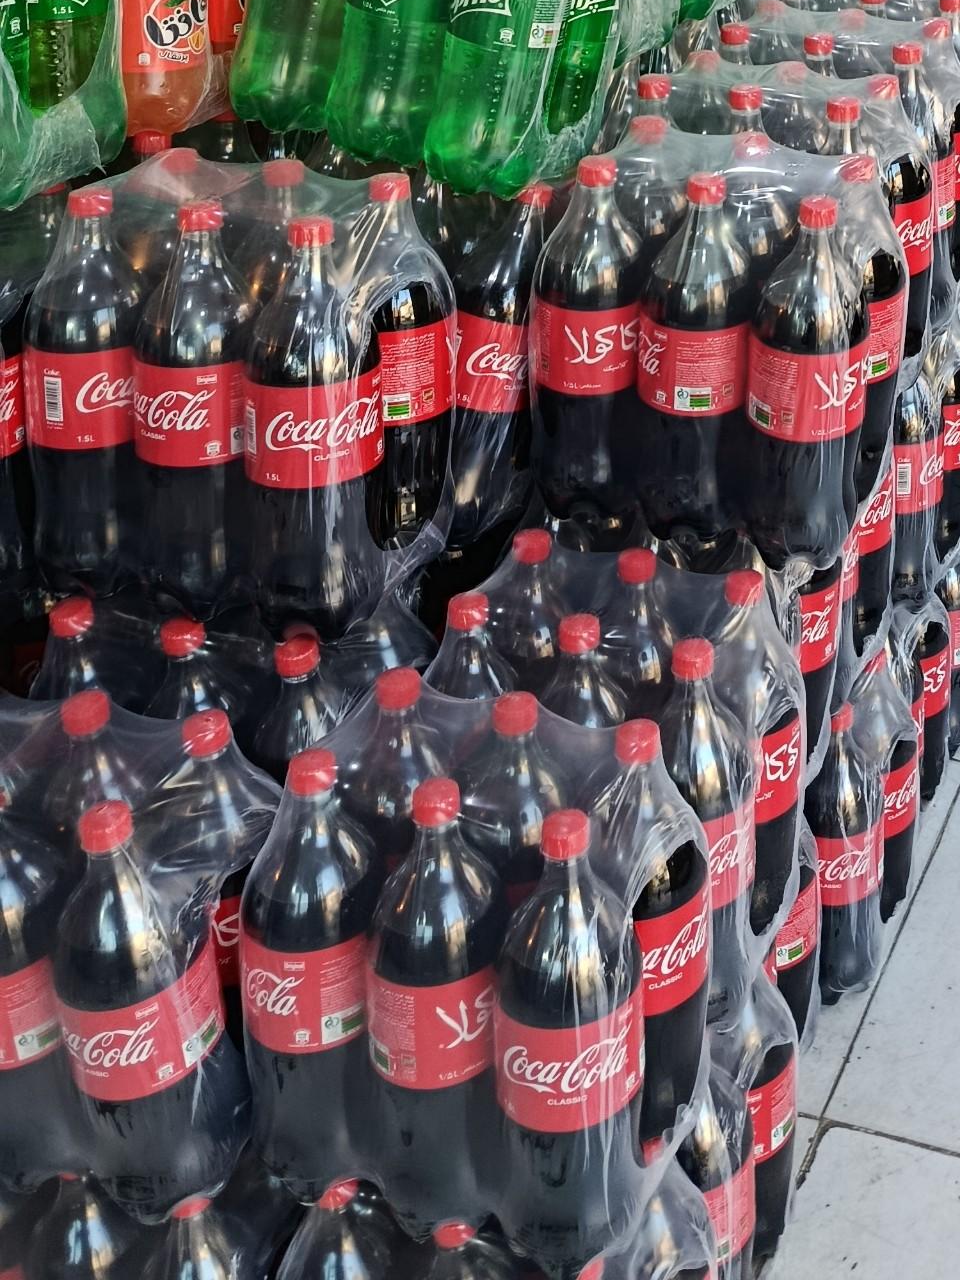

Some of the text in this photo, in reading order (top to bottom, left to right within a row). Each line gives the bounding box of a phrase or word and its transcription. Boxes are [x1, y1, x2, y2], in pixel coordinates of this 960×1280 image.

[134, 388, 217, 432] ca-Cola
[265, 390, 381, 452] Coca-Cola
[76, 434, 96, 443] 1.5L
[140, 428, 167, 441] CLASSIC
[313, 448, 351, 462] CLASSIC
[265, 472, 281, 482] 1.5L
[648, 972, 683, 990] CLASSIC
[502, 1020, 633, 1094] Coca-Cola
[546, 1094, 588, 1106] CLASSIC
